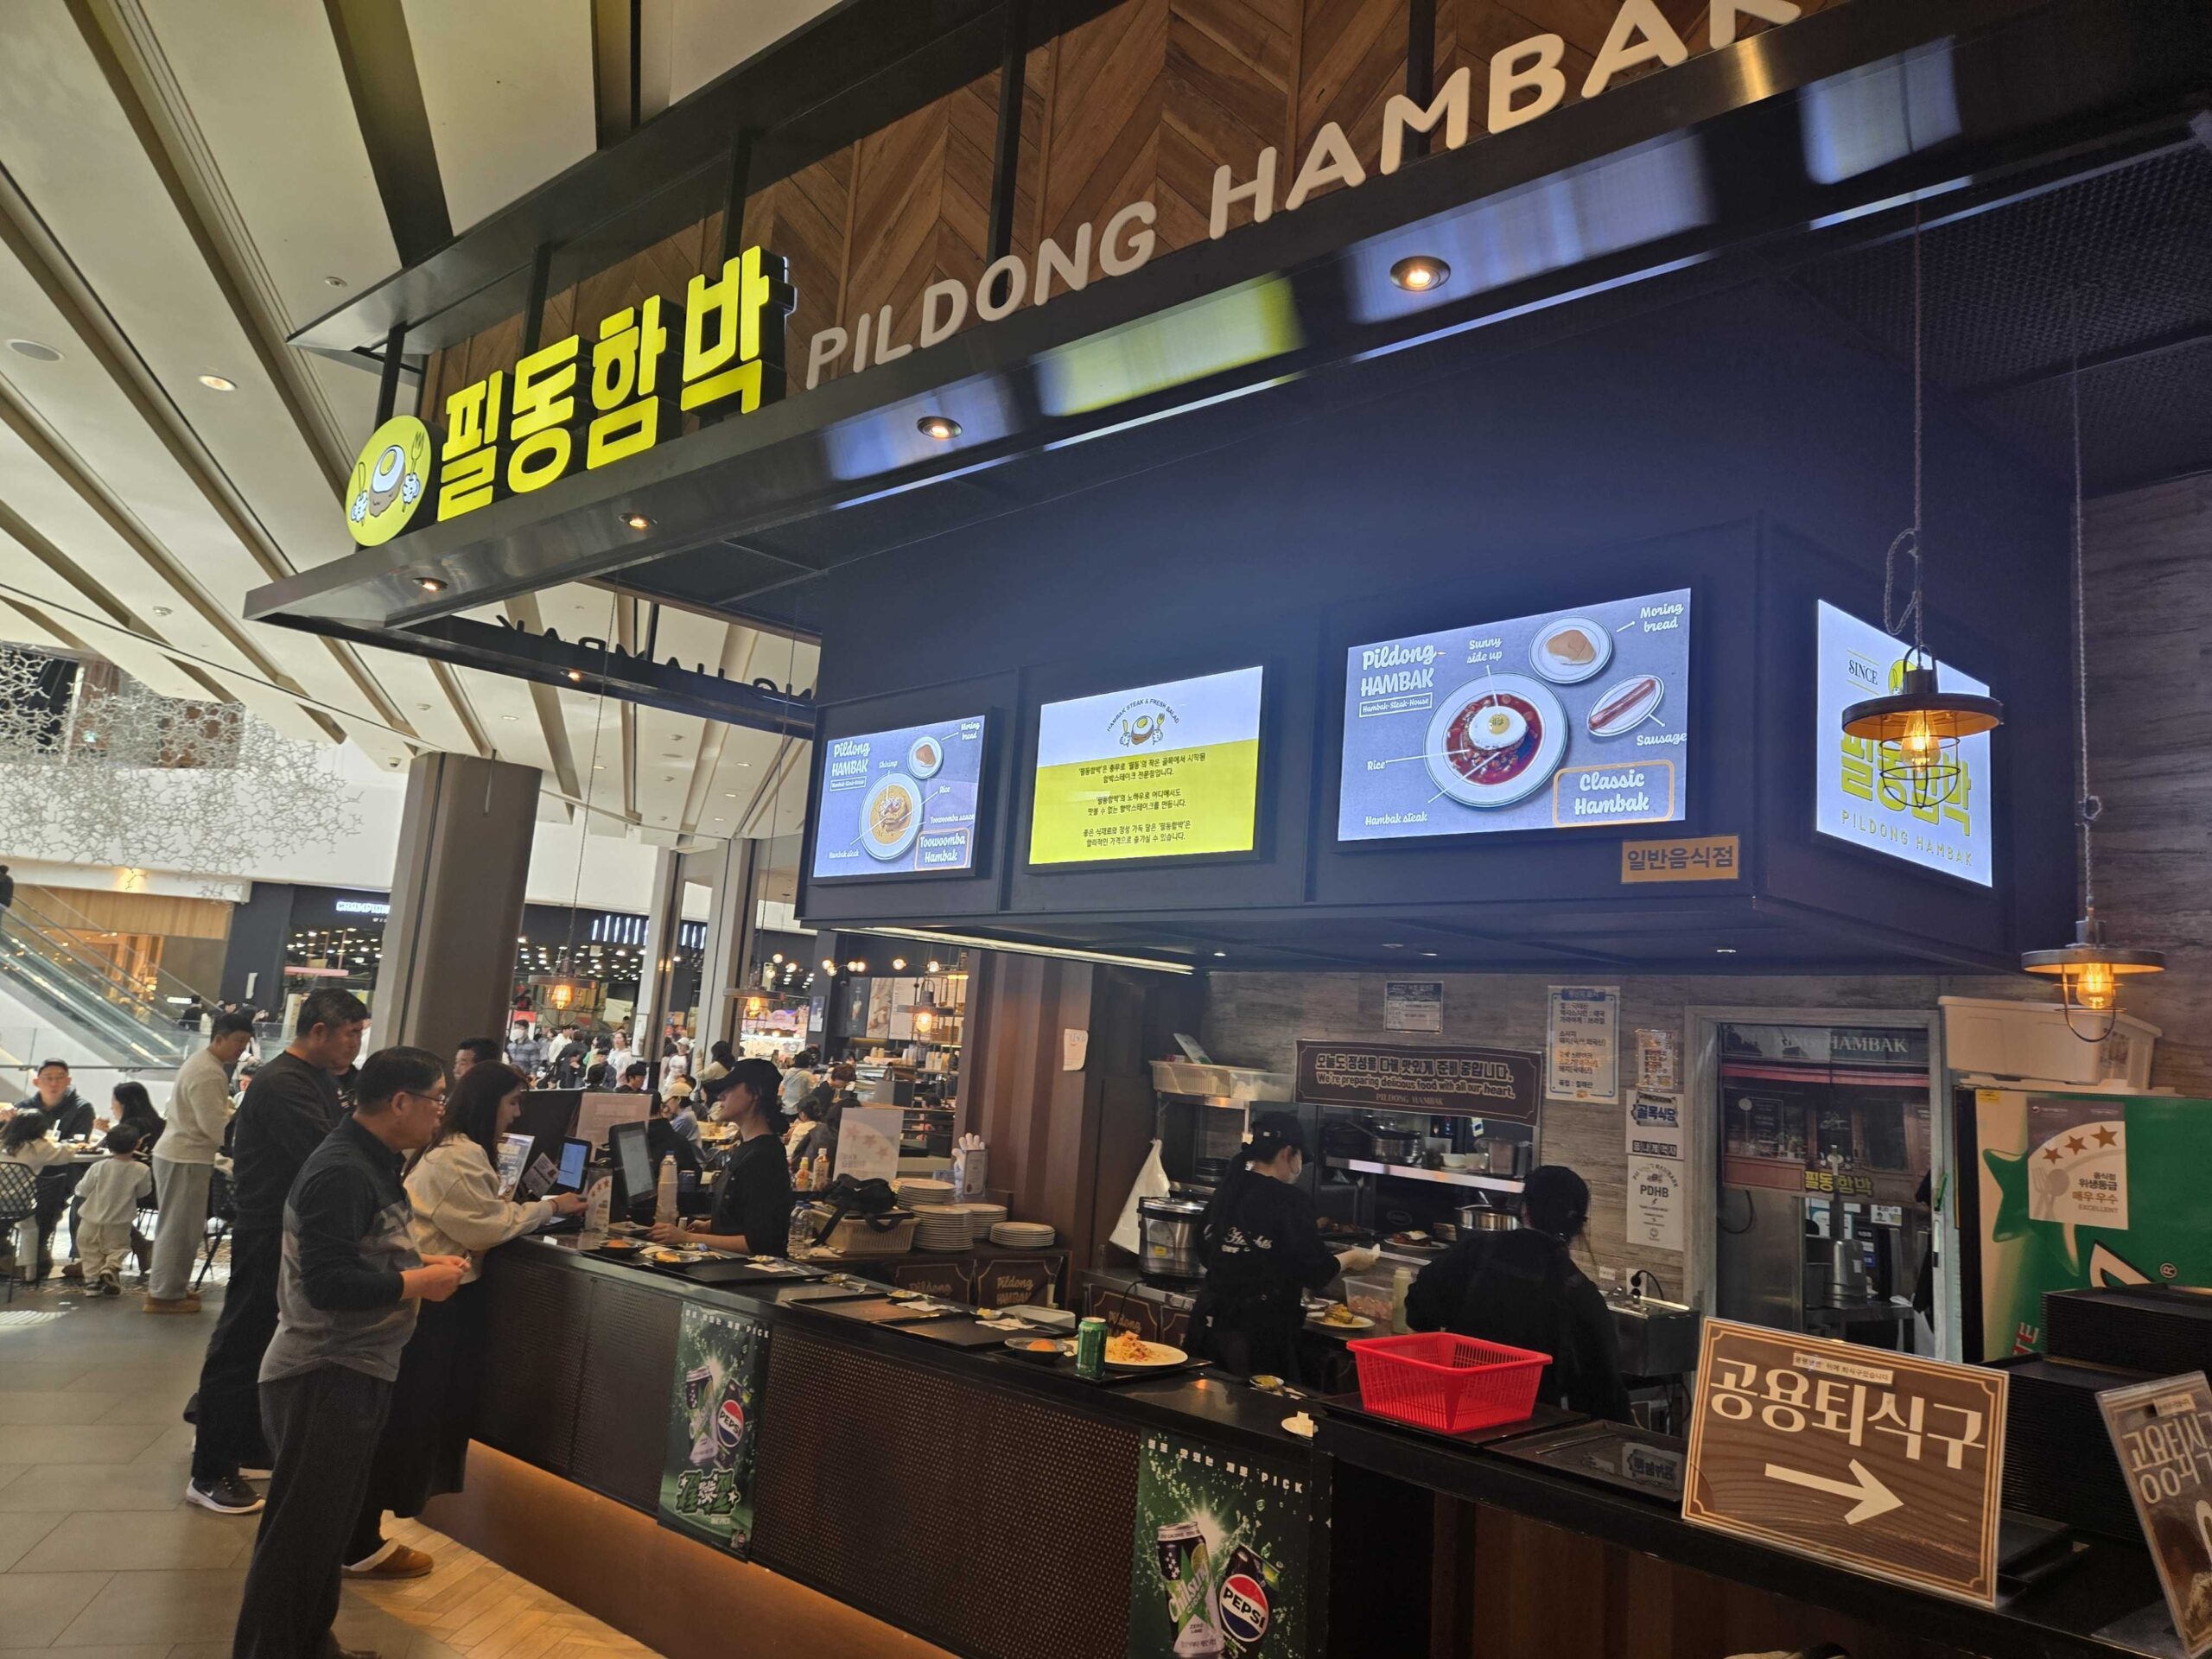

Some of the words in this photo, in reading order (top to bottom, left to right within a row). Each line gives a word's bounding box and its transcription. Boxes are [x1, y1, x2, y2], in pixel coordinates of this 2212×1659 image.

[805, 200, 1158, 390] PILDONG
[437, 245, 769, 522] 필동함박
[1640, 602, 1684, 620] Moring
[1643, 617, 1678, 633] bread
[1469, 636, 1502, 652] Sunny
[1362, 643, 1437, 671] Pildong
[1467, 651, 1487, 664] side
[1489, 649, 1503, 663] up
[1848, 659, 1878, 685] SINCE
[1361, 667, 1433, 696] HAMBAK
[1126, 699, 1144, 710] STEAK
[1150, 698, 1166, 709] FRESH
[1166, 706, 1179, 724] SALAD
[1637, 731, 1688, 747] Sausage
[834, 741, 871, 758] Pildong
[832, 759, 869, 777] HAMBAK
[1367, 760, 1385, 771] Rice
[1103, 772, 1135, 784] 함박스테이크
[1580, 770, 1645, 792] Classic
[1574, 792, 1649, 816] Hambak
[1365, 813, 1401, 827] Hambak
[1402, 810, 1427, 823] steak
[920, 832, 965, 848] Toowoomba
[1841, 810, 1908, 845] PILDONG
[1916, 835, 1972, 866] HAMBAK
[924, 849, 957, 863] Hambak
[1628, 845, 1733, 872] 일반음식점
[1830, 1035, 1908, 1053] HAMBAK
[1316, 1054, 1346, 1071] 오늘도
[1347, 1055, 1378, 1072] 정성을
[1401, 1058, 1434, 1076] 맛있게
[1436, 1059, 1459, 1077] 준비
[1460, 1060, 1515, 1083] 중입니다.
[1316, 1071, 1341, 1084] We're
[1341, 1075, 1380, 1089] preparing
[1380, 1076, 1415, 1090] delicious
[1416, 1078, 1437, 1091] food
[1438, 1079, 1454, 1092] with
[1455, 1080, 1467, 1093] all
[1467, 1083, 1483, 1095] our
[1483, 1083, 1516, 1100] heart.
[1376, 1093, 1409, 1103] PILDONG
[1637, 1104, 1675, 1122] 골목식당
[1805, 1169, 1874, 1198] 필동함박
[2078, 1179, 2118, 1192] 위생등급
[2093, 1172, 2116, 1181] 음식점
[1640, 1185, 1669, 1198] PDHB
[2072, 1192, 2094, 1202] 매우
[2096, 1192, 2118, 1205] 우수
[2077, 1204, 2119, 1214] EXCELLENT
[909, 1281, 953, 1294] Pildong
[997, 1276, 1033, 1291] Pildong
[746, 1325, 769, 1338] PICK
[1711, 1357, 1986, 1470] 공용퇴식구
[719, 1410, 741, 1438] PEPSI
[1261, 1471, 1303, 1494] PICK
[1224, 1586, 1265, 1630] PEPSI
